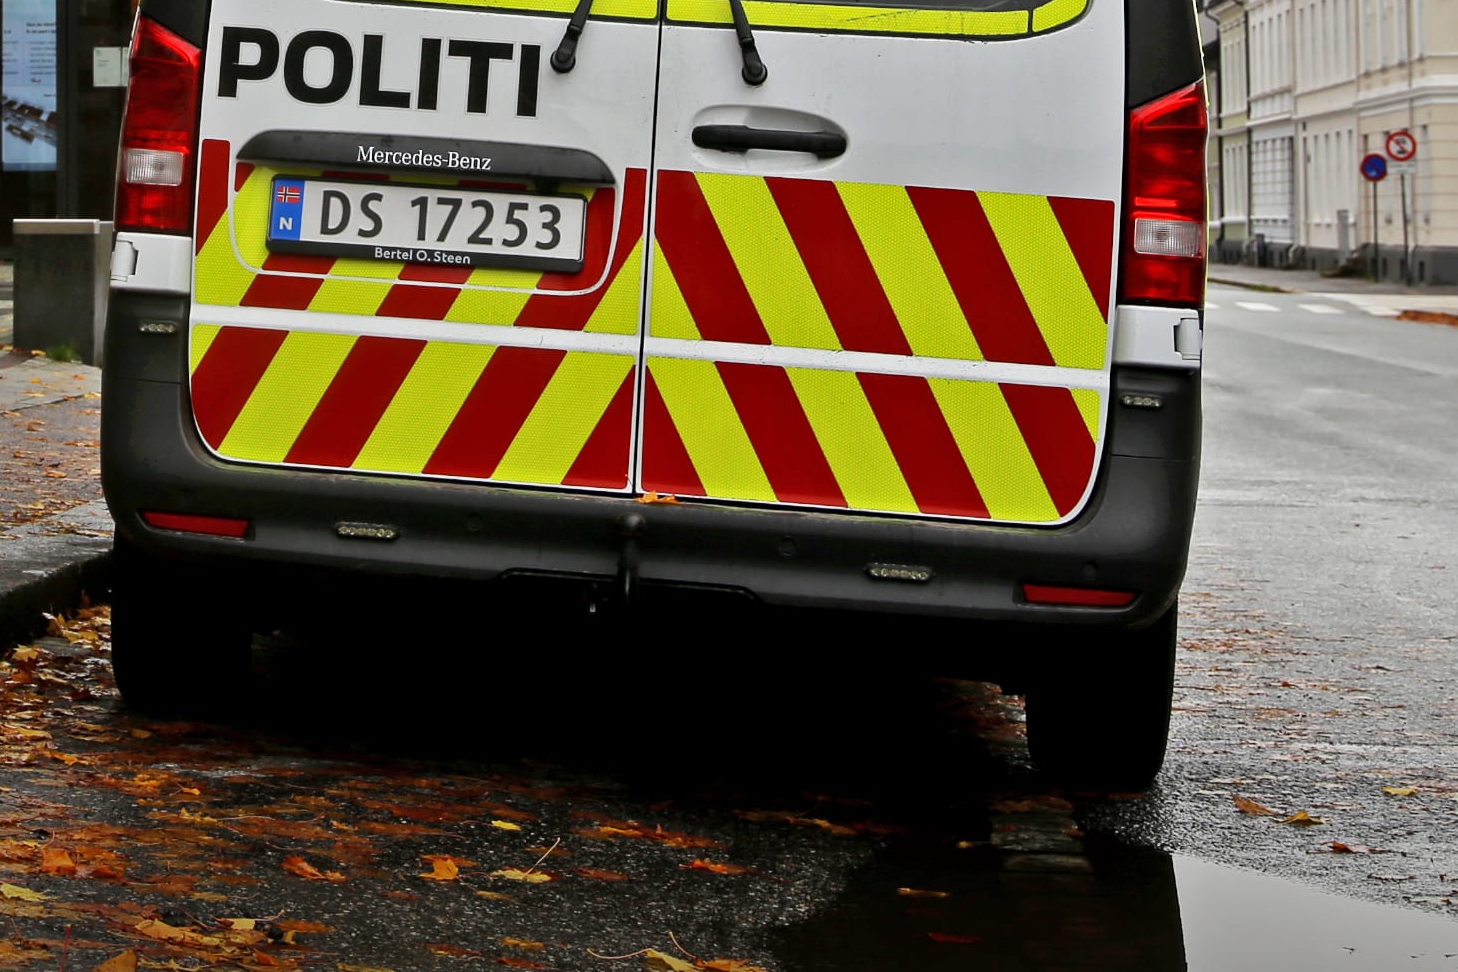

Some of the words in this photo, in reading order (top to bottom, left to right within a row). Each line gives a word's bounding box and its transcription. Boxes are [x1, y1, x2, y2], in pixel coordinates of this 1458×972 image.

[217, 26, 541, 117] POLITI
[356, 145, 492, 171] Mercedes-Benz
[279, 216, 293, 231] N
[320, 189, 384, 239] DS
[410, 195, 562, 251] 17253
[374, 246, 414, 262] Bertel
[416, 249, 432, 263] O.
[436, 251, 471, 266] Steen
